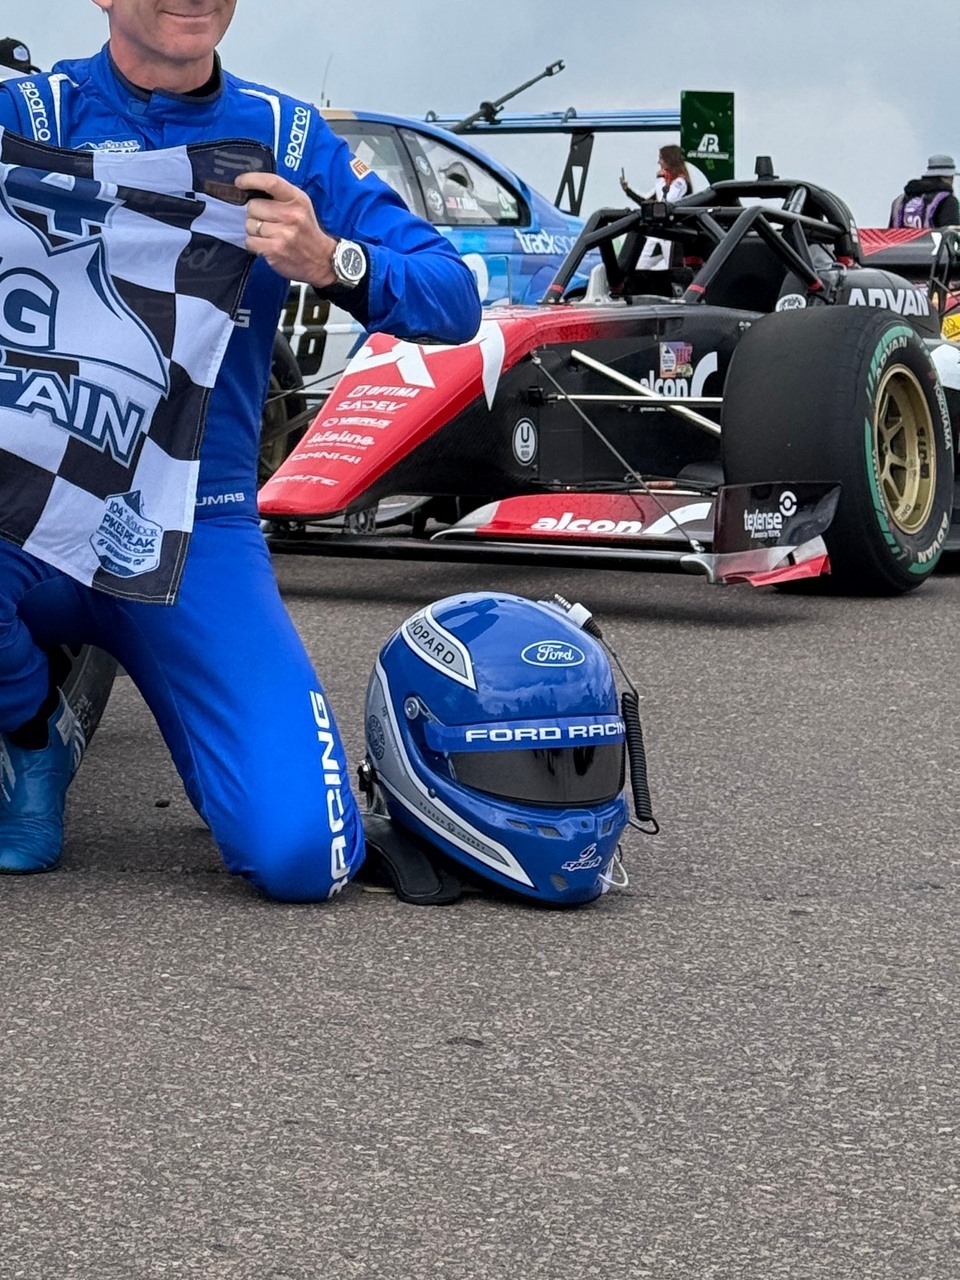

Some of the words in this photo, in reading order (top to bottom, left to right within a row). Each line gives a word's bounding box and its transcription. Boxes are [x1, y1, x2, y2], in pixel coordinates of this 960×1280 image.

[18, 81, 51, 142] sparco
[284, 106, 311, 171] sparco
[848, 287, 930, 317] ADVAN
[875, 336, 908, 385] ADVAN
[366, 387, 420, 398] OPTIMA
[640, 370, 689, 398] alcon
[336, 401, 408, 411] SADEV
[195, 492, 246, 507] UMAS
[530, 512, 643, 534] alcon
[122, 528, 157, 549] PEAK
[409, 614, 455, 666] HOPARD
[536, 643, 575, 663] Ford
[465, 725, 562, 743] FORD
[568, 721, 627, 739] RACIN
